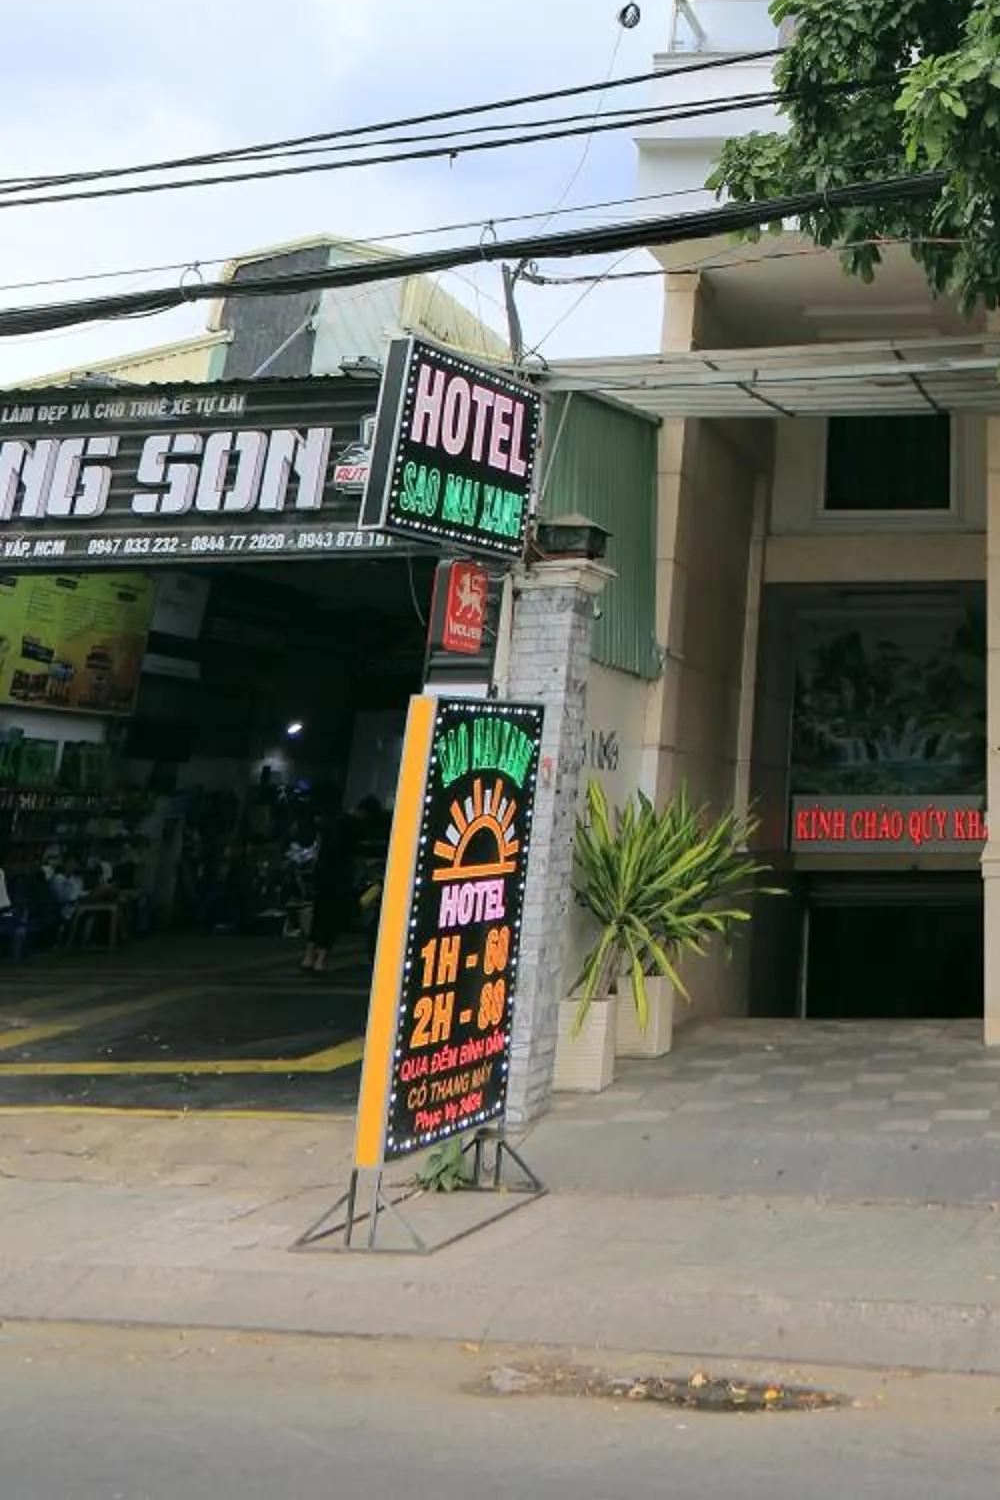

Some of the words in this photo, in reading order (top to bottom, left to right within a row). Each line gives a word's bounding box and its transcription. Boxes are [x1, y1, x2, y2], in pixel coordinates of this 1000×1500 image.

[410, 363, 527, 477] HOTEL
[401, 461, 441, 518] SAO
[34, 539, 67, 556] HCM
[438, 879, 506, 929] HOTEL
[420, 935, 461, 988] 1H
[411, 991, 455, 1049] 2H
[400, 1055, 429, 1082] QUA
[407, 1079, 428, 1109] CÓ
